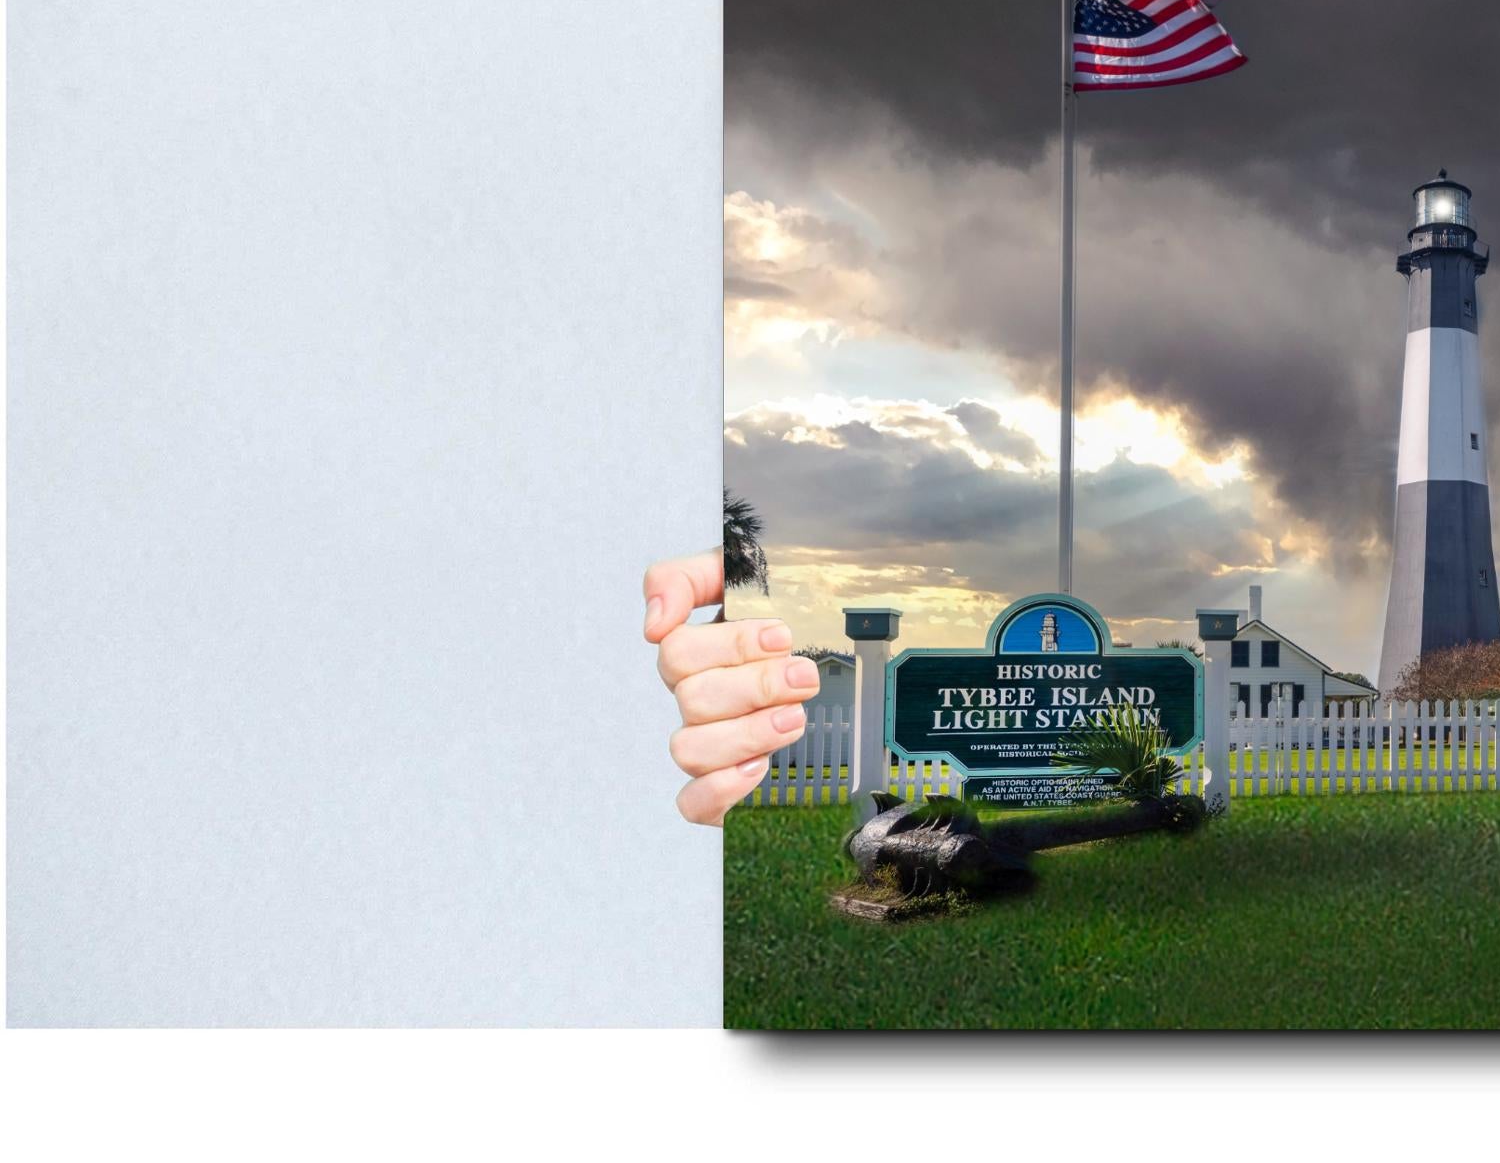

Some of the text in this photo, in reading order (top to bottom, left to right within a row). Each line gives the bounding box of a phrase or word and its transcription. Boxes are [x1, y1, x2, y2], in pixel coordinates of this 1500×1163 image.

[997, 664, 1102, 680] HISTORIC
[938, 686, 1156, 708] TYBEE ISLAND
[932, 707, 1161, 730] LIGHT STATION
[970, 743, 1020, 751] OPERATED
[1022, 742, 1035, 750] BY
[998, 750, 1053, 758] HISTORICAL
[992, 779, 1029, 787] HISTORIC
[1034, 792, 1063, 800] STATES
